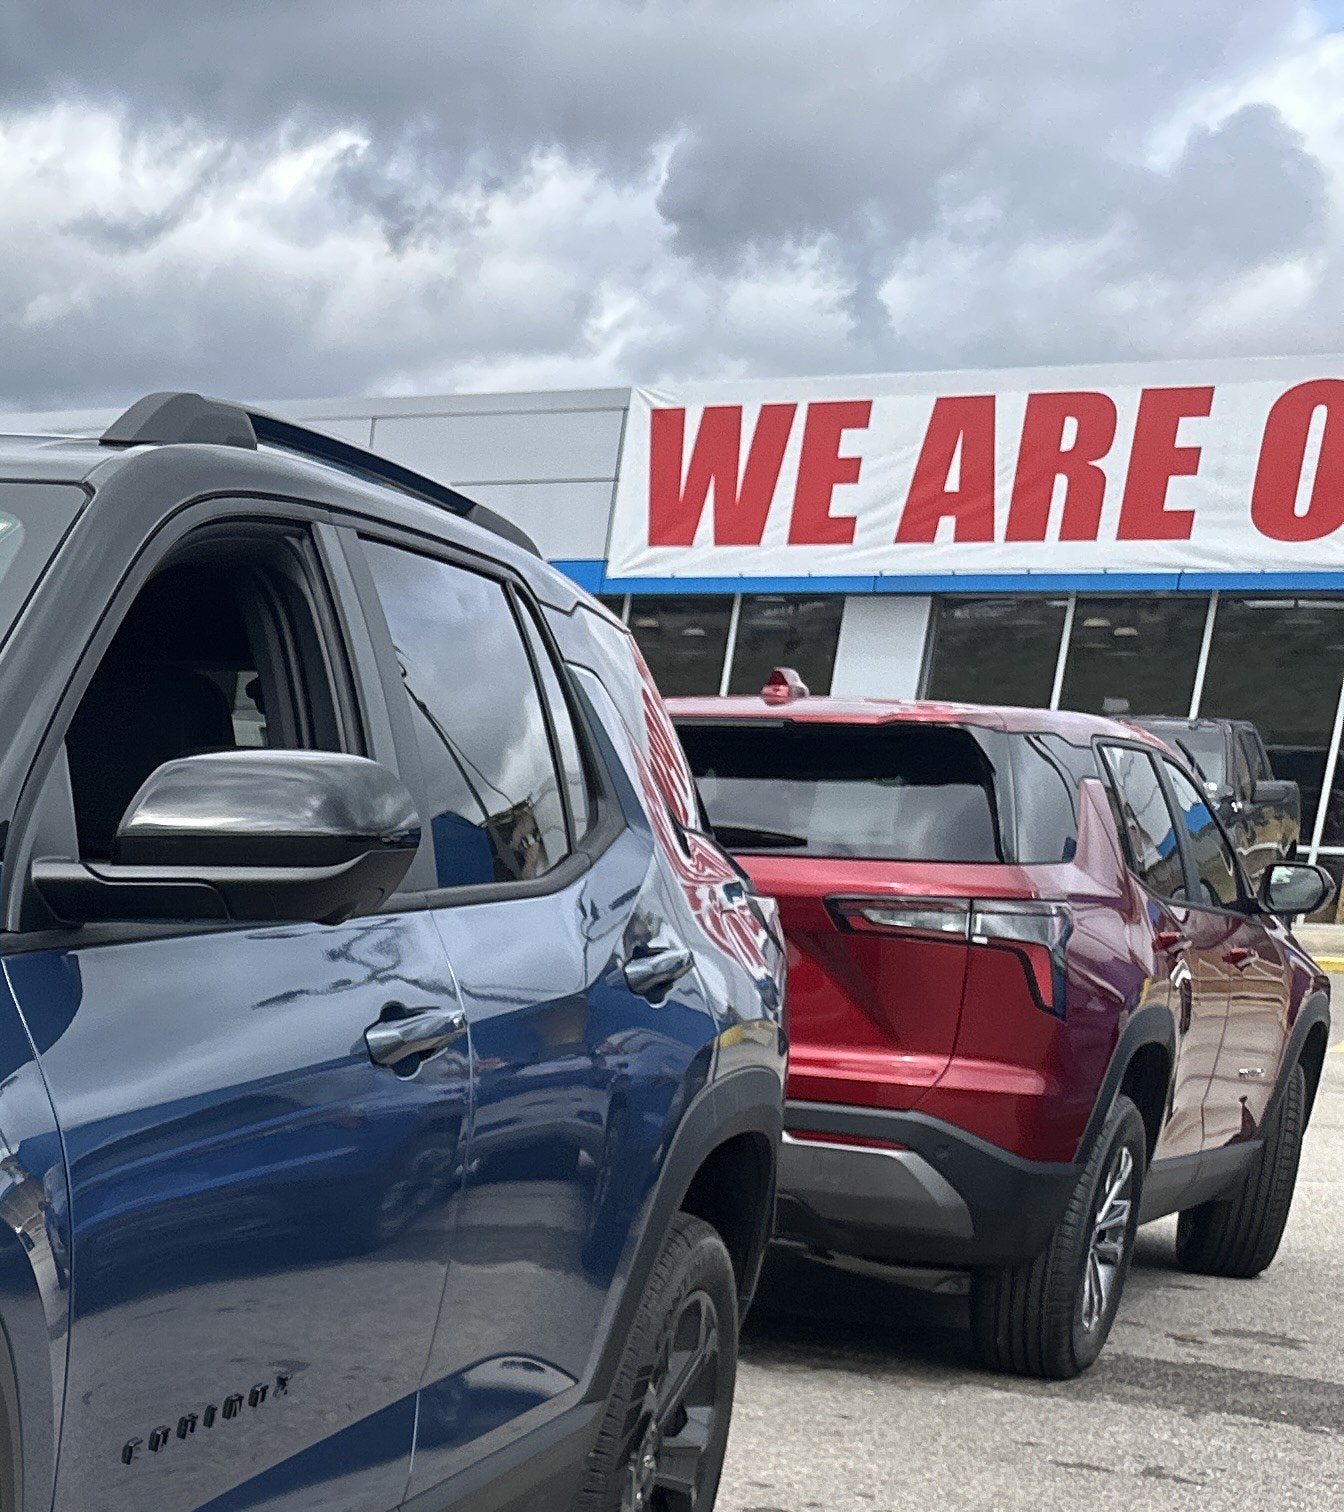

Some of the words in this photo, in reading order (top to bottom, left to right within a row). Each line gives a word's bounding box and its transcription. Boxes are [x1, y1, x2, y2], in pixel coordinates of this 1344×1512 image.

[647, 399, 874, 547] WE
[894, 386, 1216, 544] ARE
[121, 1373, 292, 1465] EQUINOX
